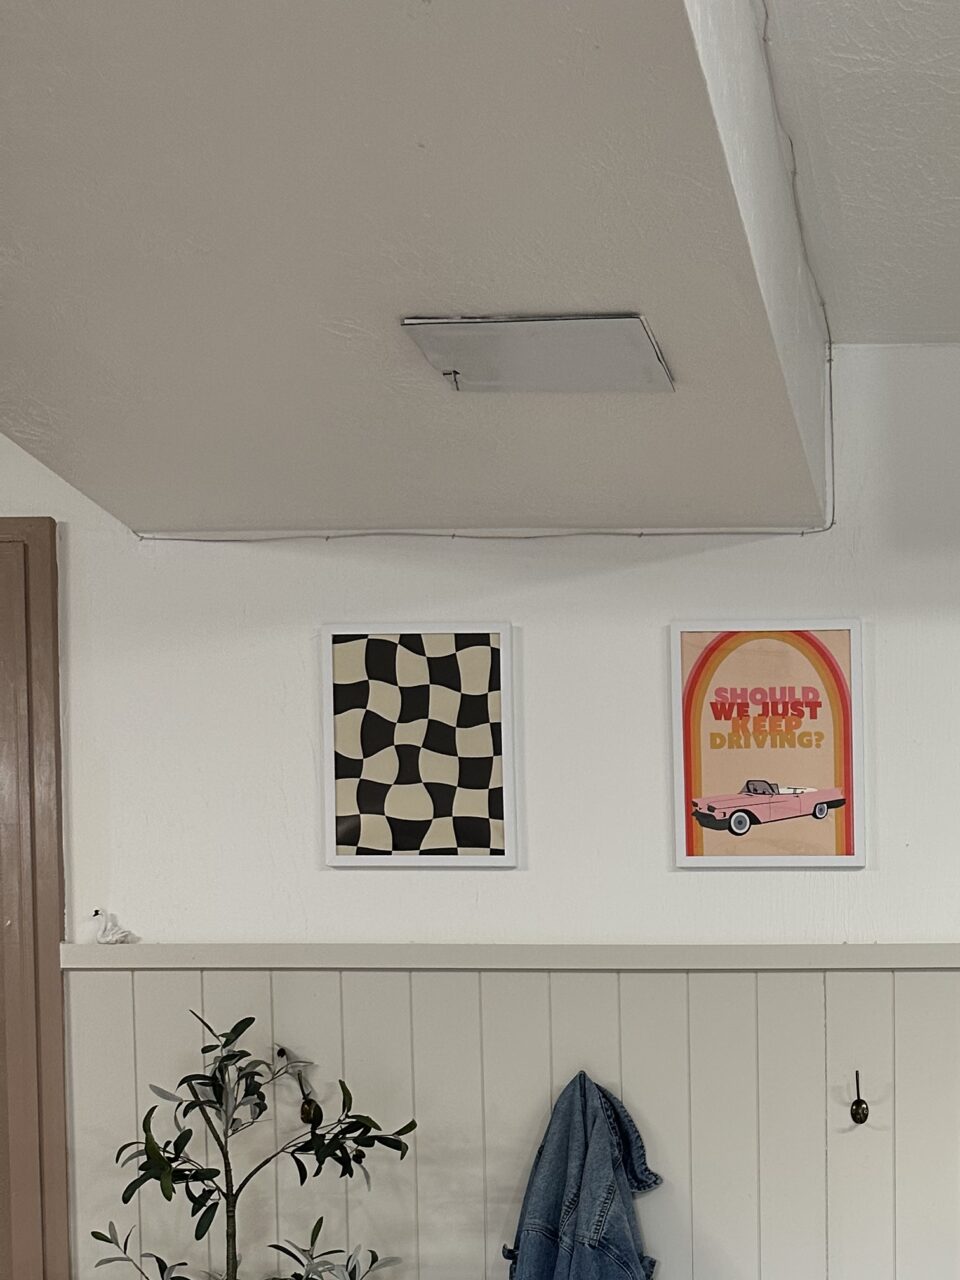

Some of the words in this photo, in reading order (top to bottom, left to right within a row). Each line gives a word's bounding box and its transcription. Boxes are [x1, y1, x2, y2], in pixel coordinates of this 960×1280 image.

[714, 686, 820, 705] SHOULD
[709, 702, 751, 721] WE
[758, 701, 822, 720] JUST
[731, 716, 803, 735] KEEP
[709, 731, 825, 750] DRIVING?
